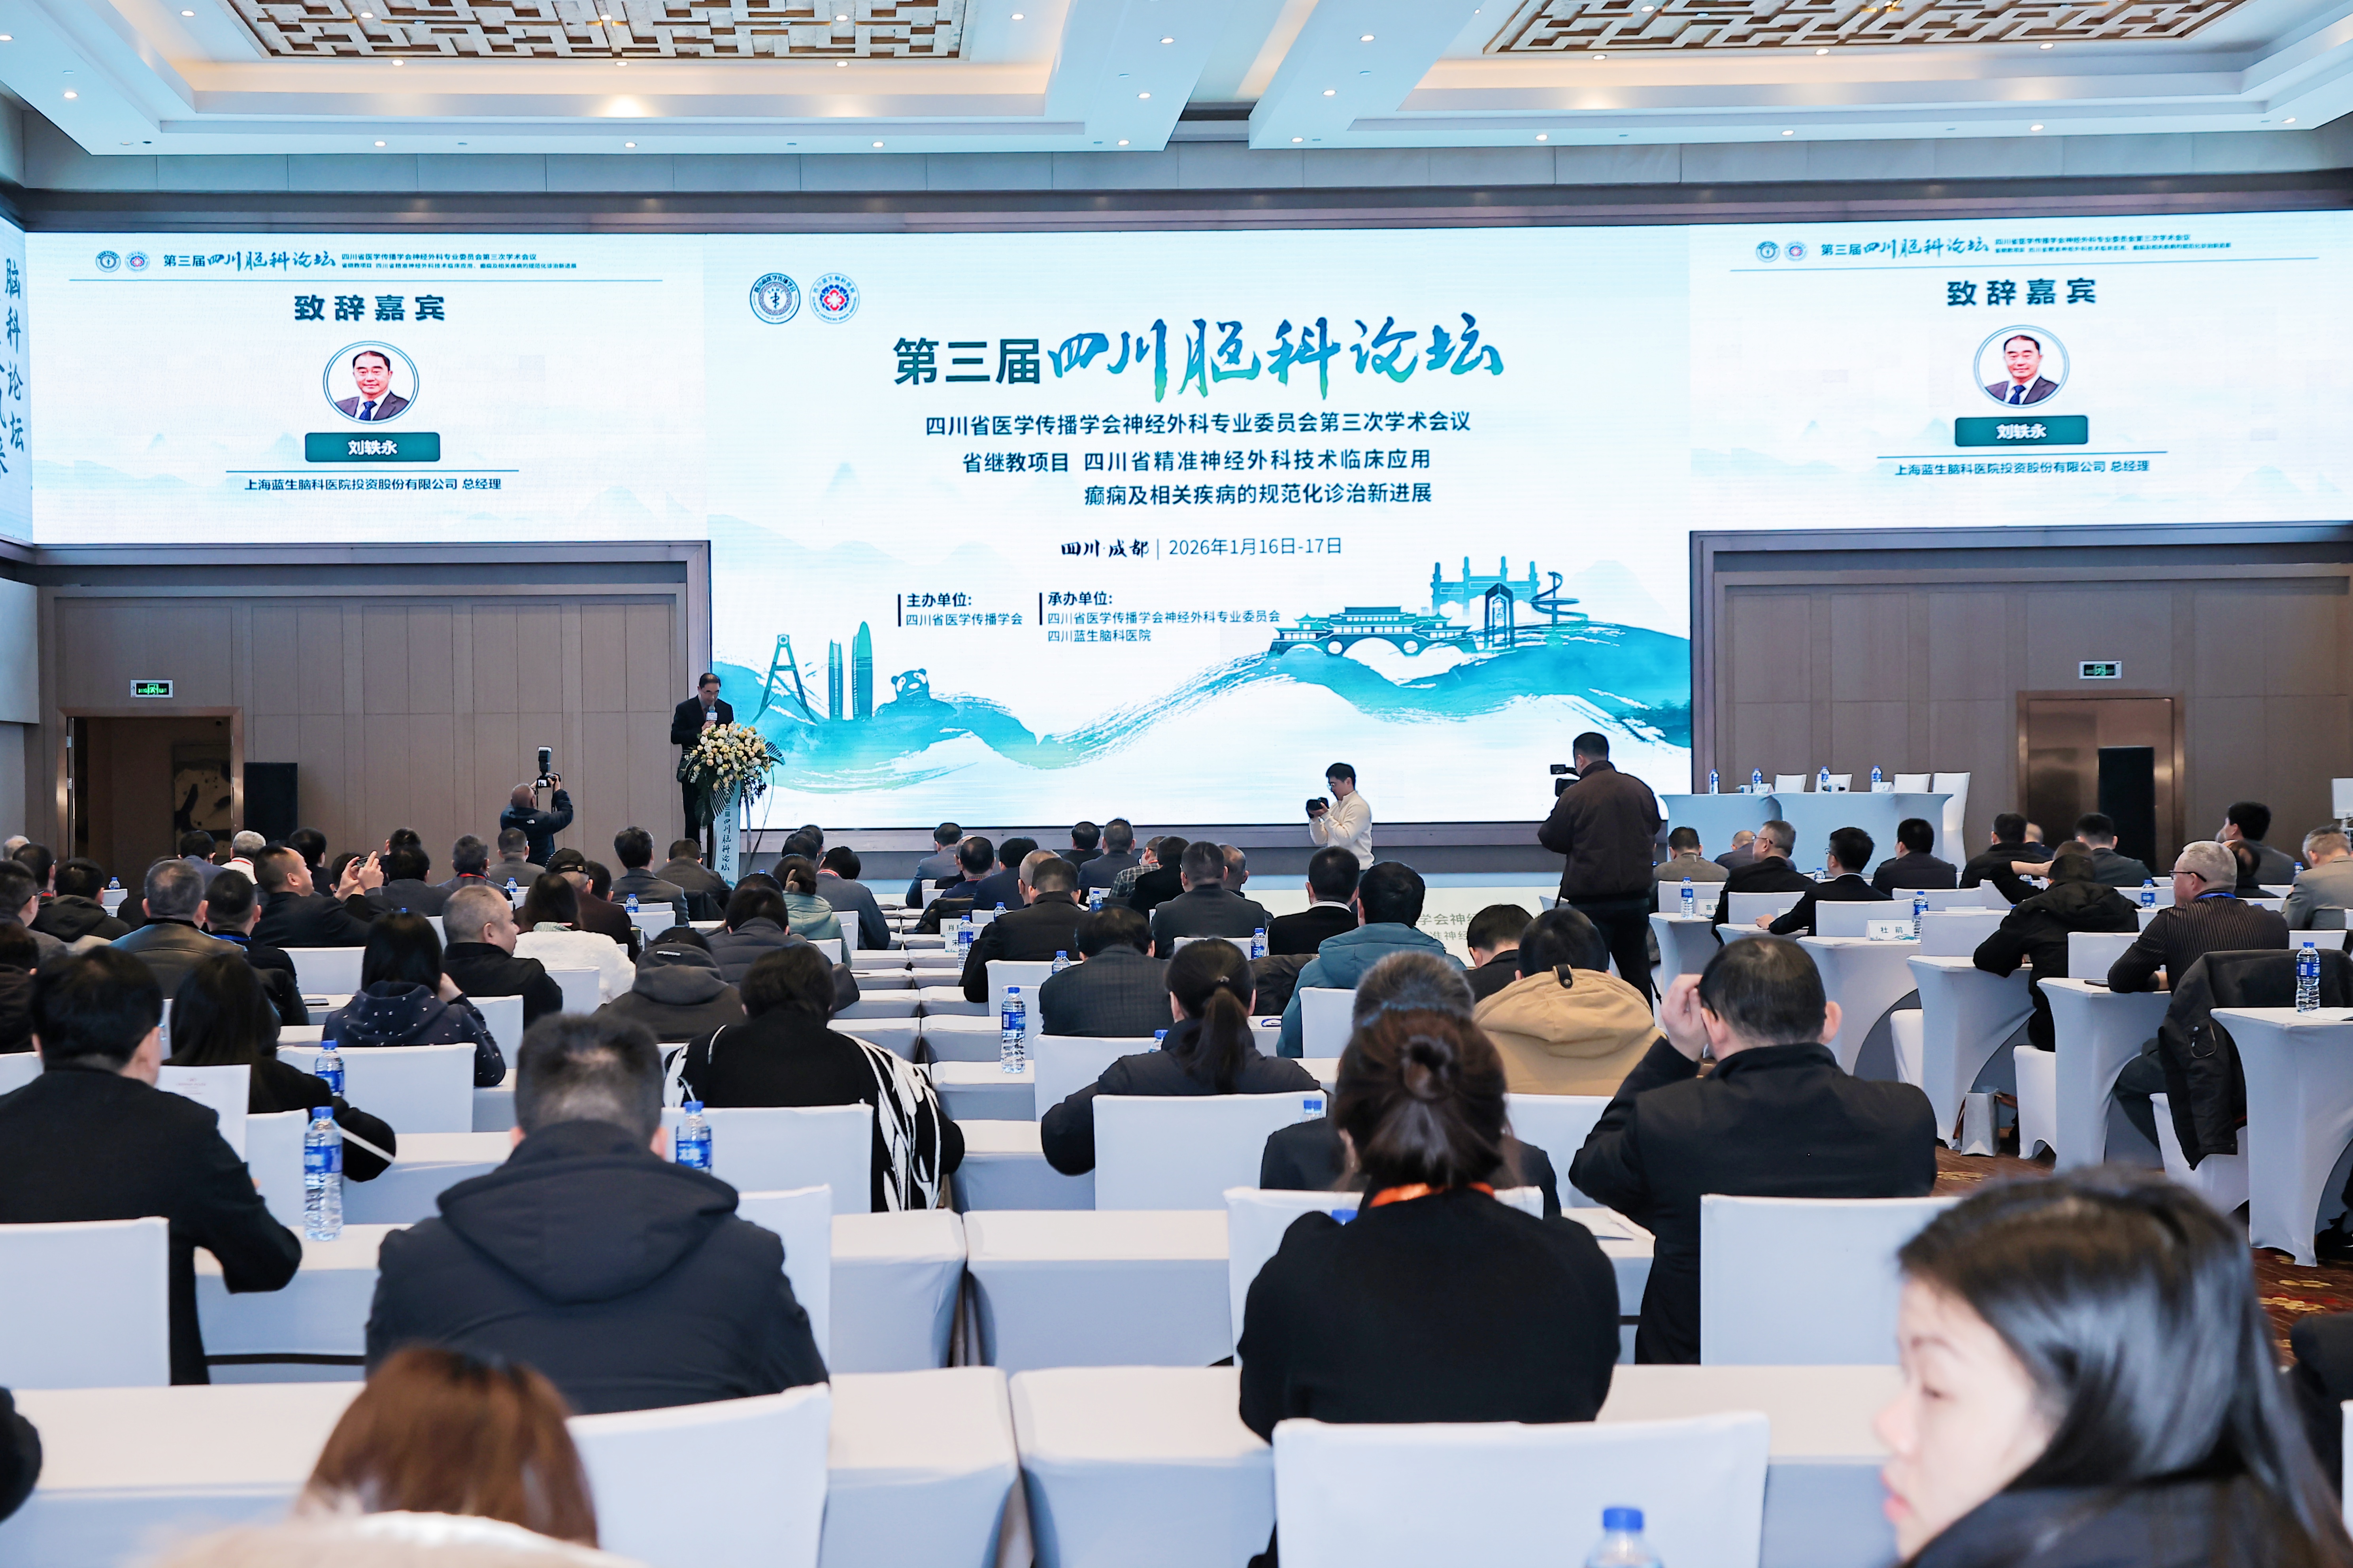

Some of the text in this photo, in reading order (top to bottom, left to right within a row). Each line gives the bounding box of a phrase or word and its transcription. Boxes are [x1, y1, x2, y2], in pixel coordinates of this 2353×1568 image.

[1947, 277, 2096, 307] 致辞嘉宾
[294, 294, 445, 321] 致辞嘉宾
[926, 411, 1471, 436] 四川省医学传播学会神经外科专业委员会第三次学术会议
[348, 440, 397, 455] 刘轶永
[963, 449, 1430, 473] 省继教项目 四川省精准神经外科技术临床应用
[1895, 460, 2149, 475] 上海蓝生脑科医院投资股份有限公司 总经理
[245, 478, 501, 490] 上海蓝生脑科医院投资股份有限公司 总经理
[1084, 482, 1432, 506] 癫痫及相关疾病的规范化诊治新进展
[1169, 537, 1341, 555] 2026年1月16日-17日
[906, 613, 1023, 626] 四川省医学传播学会
[1048, 610, 1280, 624] 四川省医学传播学会神经外科专业委员会
[1048, 629, 1151, 642] 四川蓝生脑科医院
[721, 804, 731, 871] 三届四川脑科论坛
